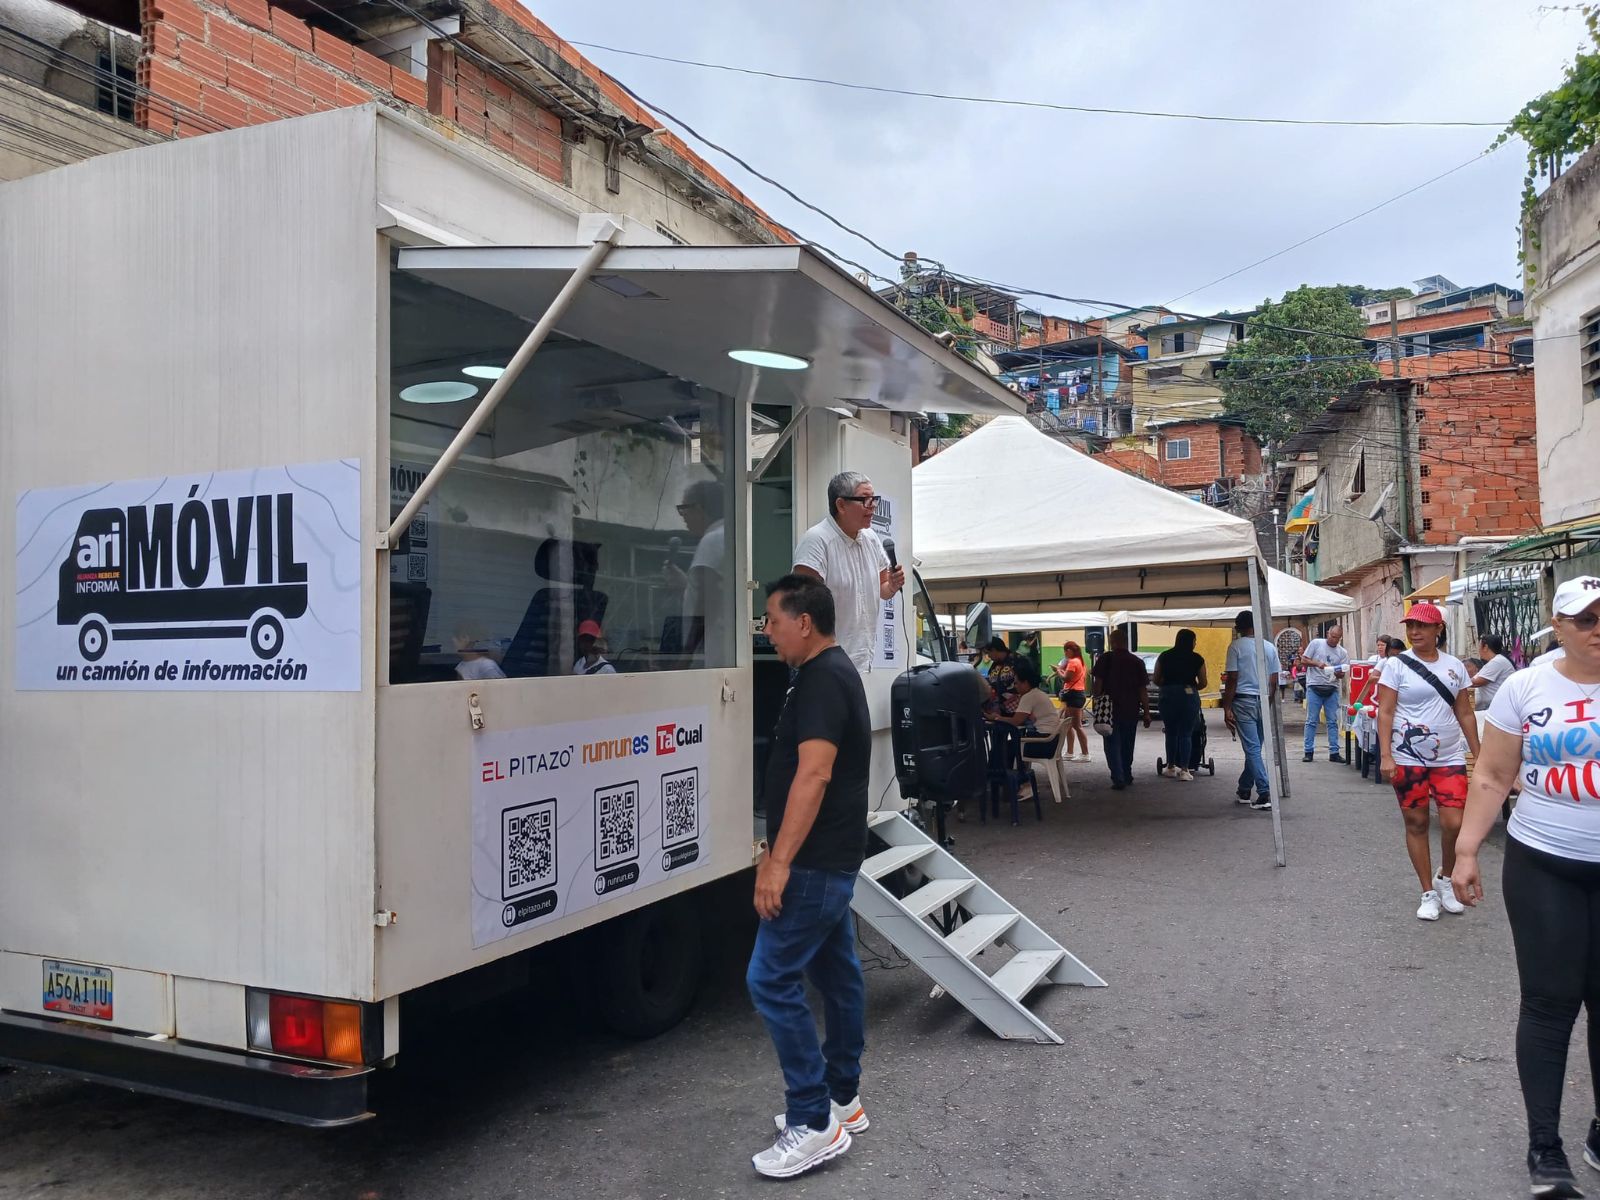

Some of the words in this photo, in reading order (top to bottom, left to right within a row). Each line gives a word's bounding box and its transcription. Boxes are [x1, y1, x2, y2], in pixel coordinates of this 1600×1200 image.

[77, 522, 120, 569] ari
[127, 484, 308, 590] MÓVIL
[76, 580, 120, 594] INFORMA
[56, 663, 78, 681] un
[82, 660, 149, 681] camión
[154, 660, 178, 681] de
[182, 658, 308, 681] información
[482, 761, 505, 782] EL
[509, 746, 573, 777] PITAZO
[582, 735, 649, 764] runrunes
[517, 899, 552, 918] elpitazo.net
[48, 972, 107, 1005] A56AI1U
